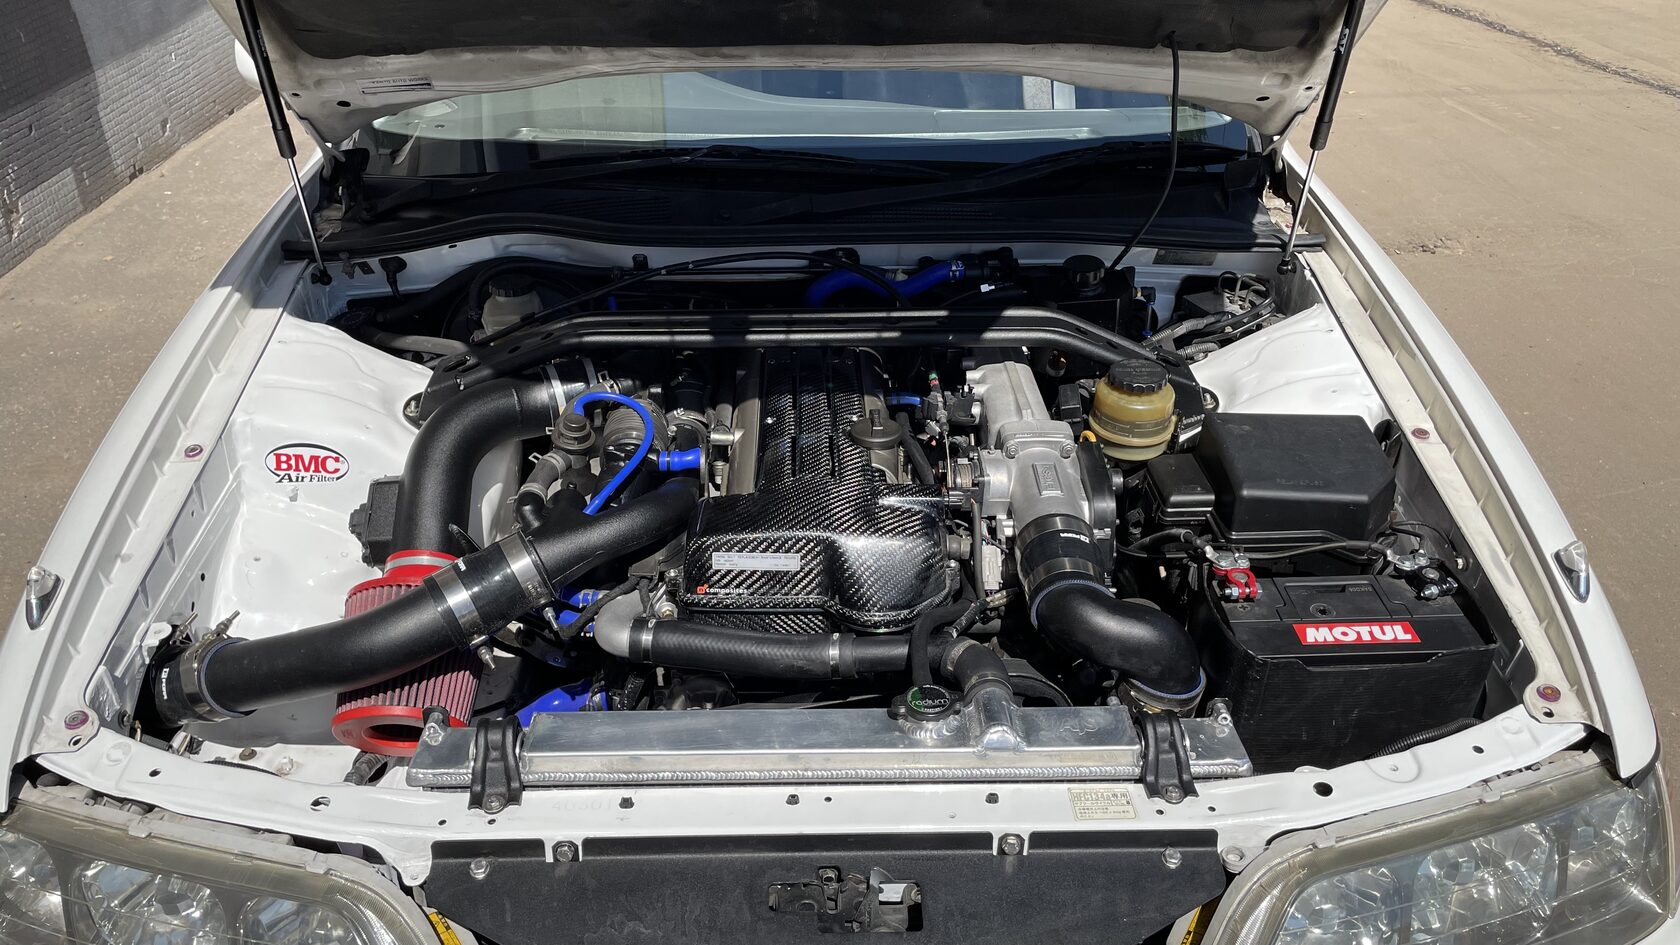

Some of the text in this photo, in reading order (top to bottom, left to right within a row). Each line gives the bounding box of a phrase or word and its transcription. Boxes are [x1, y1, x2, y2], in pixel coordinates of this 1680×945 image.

[273, 453, 340, 474] BMC
[275, 473, 337, 483] Air Filter
[1306, 625, 1412, 642] MOTUL
[911, 698, 949, 706] radium
